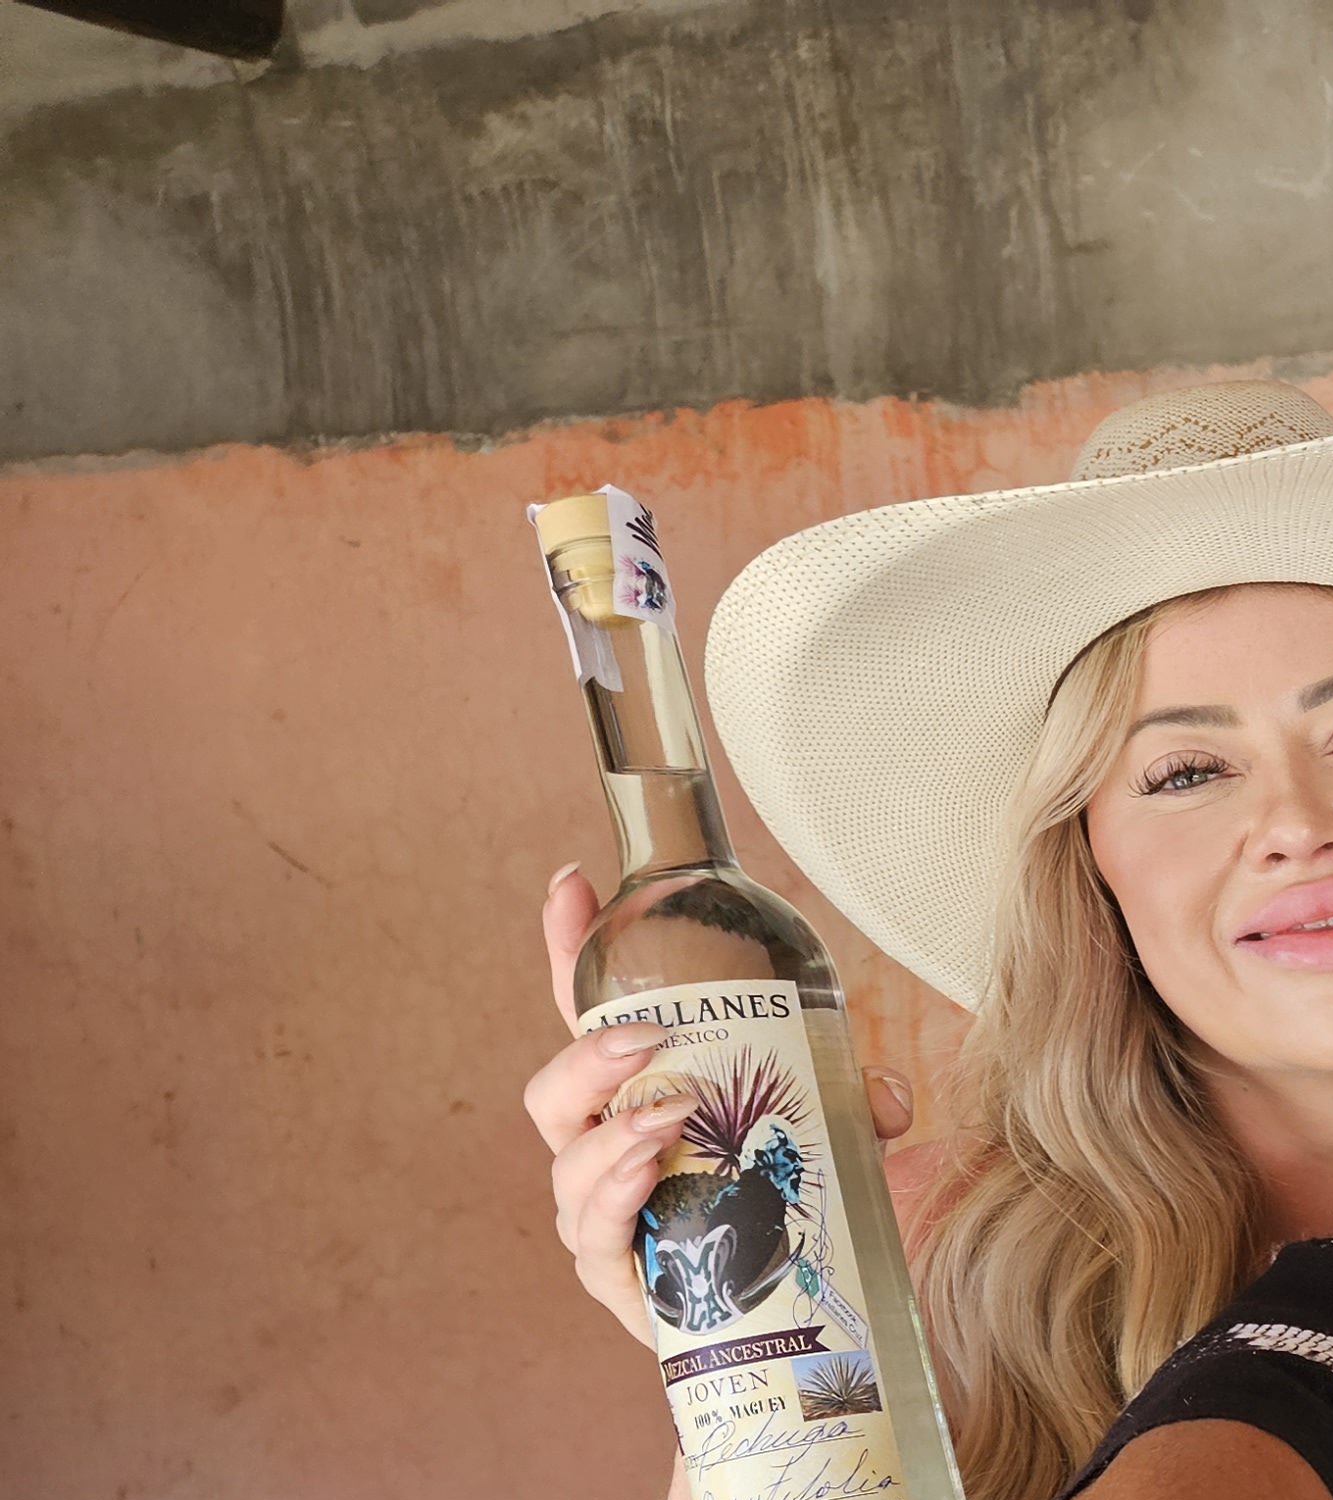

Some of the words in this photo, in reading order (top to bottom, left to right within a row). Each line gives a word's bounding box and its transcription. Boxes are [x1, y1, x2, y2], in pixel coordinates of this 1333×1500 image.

[664, 1355, 707, 1381] MEZCAL
[709, 1335, 813, 1369] ANCESTRAL
[686, 1368, 770, 1406] JOVEN
[729, 1396, 787, 1420] MAGUEY
